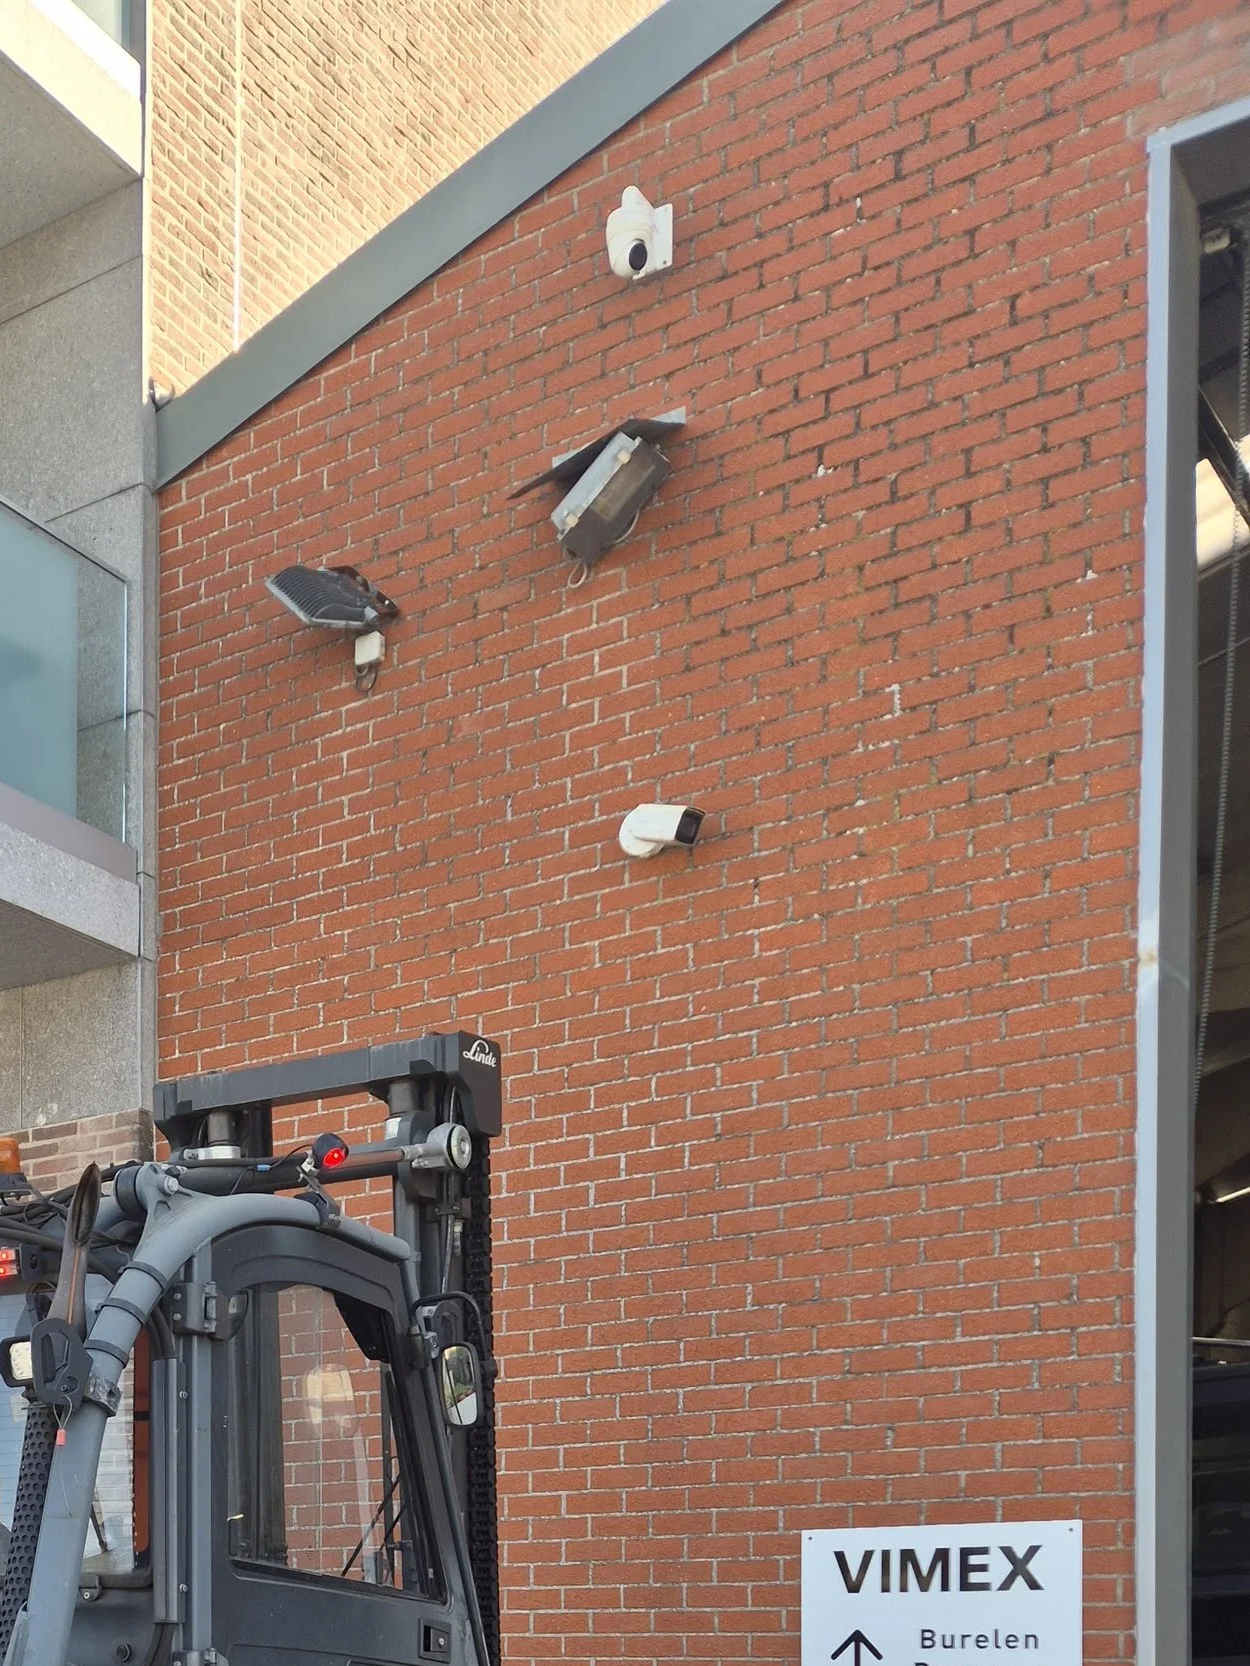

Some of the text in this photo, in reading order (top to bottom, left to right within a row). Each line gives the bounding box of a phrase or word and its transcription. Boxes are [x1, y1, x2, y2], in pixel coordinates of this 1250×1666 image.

[462, 1040, 497, 1068] Linde
[833, 1544, 1045, 1594] VIMEX
[920, 1628, 1040, 1650] Burelen
